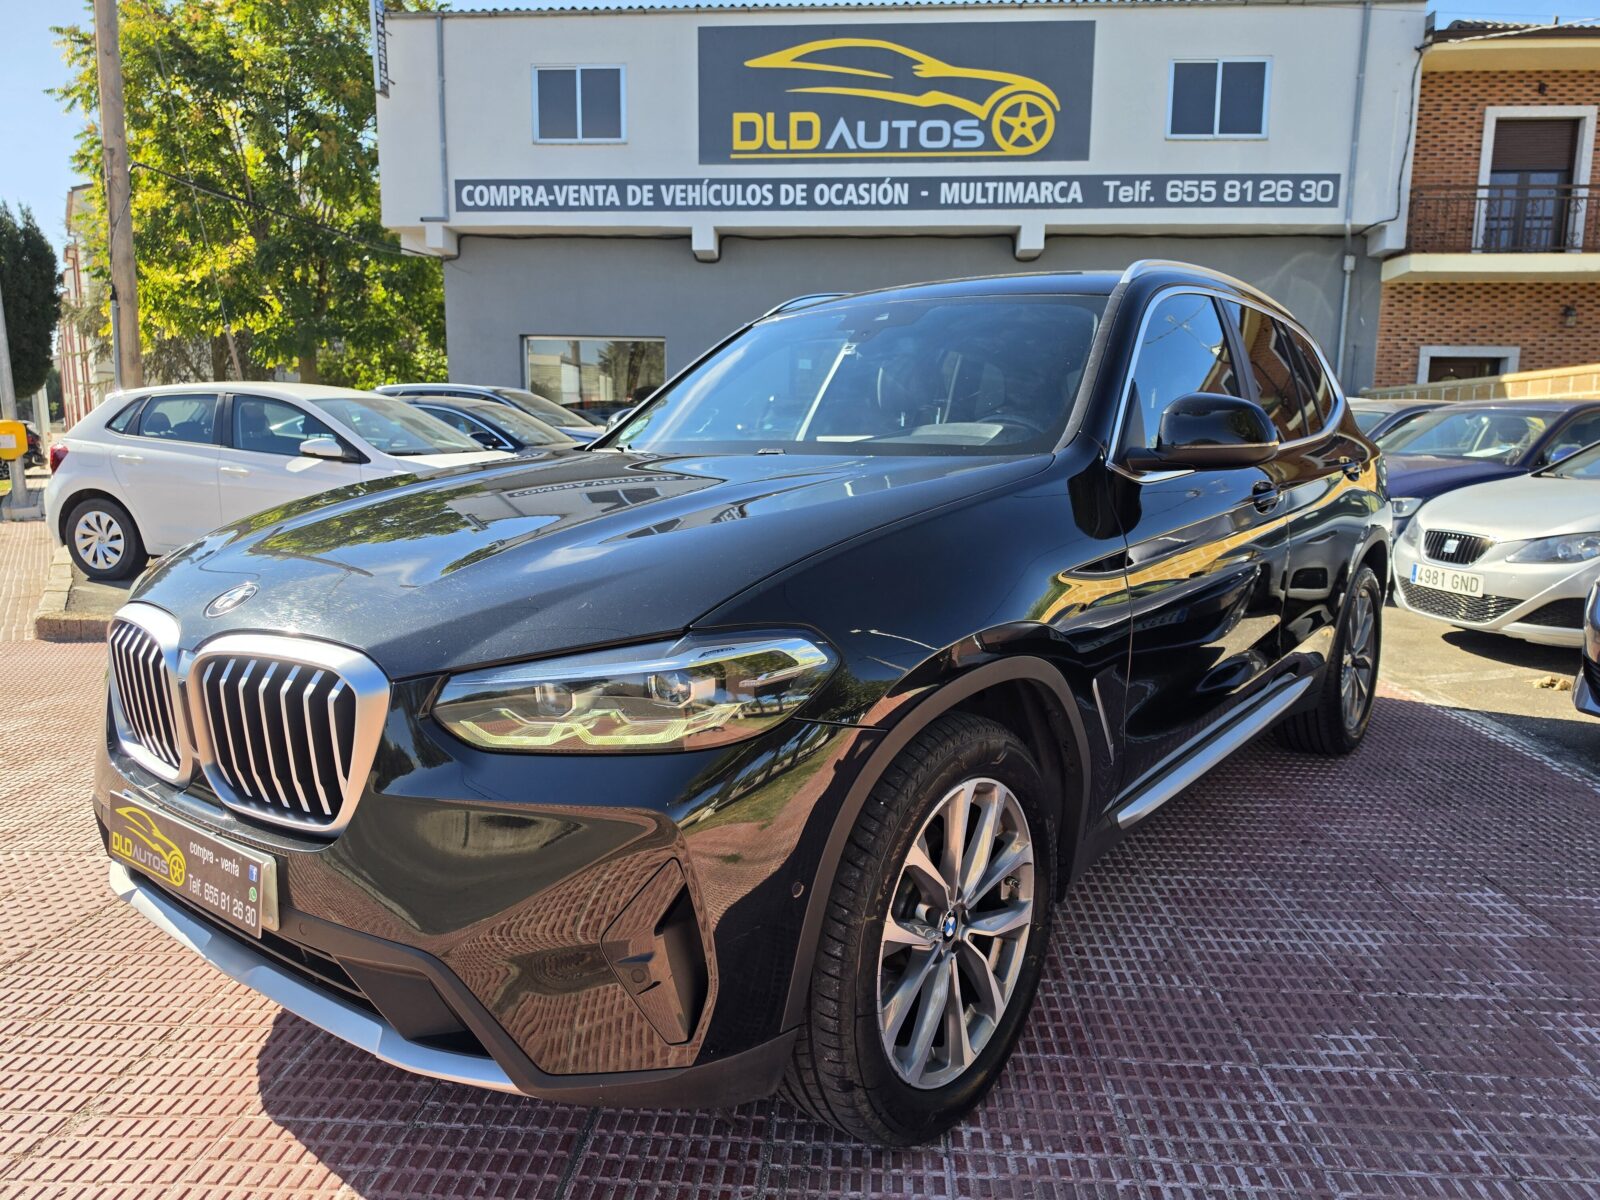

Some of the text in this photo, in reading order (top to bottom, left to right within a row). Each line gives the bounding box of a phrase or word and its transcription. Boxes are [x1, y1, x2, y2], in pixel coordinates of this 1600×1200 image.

[732, 112, 985, 150] DLD AUTOS
[461, 184, 620, 207] COMPRA-VENTA
[627, 184, 654, 206] DE
[660, 178, 774, 206] VEHÍCULOS
[780, 183, 807, 205] DE
[814, 178, 909, 205] OCASIÓN
[940, 181, 1083, 204] MULTIMARCA
[1103, 180, 1155, 203] Telf.
[1165, 180, 1217, 203] 655
[1300, 179, 1334, 202] 30
[1417, 567, 1479, 593] 4981 GND
[112, 831, 169, 875] DLD AUTOS
[189, 841, 214, 865] compra
[220, 857, 240, 878] venta
[204, 883, 219, 906] 655
[220, 891, 231, 913] 81
[232, 898, 243, 921] 26
[245, 906, 257, 928] 30
